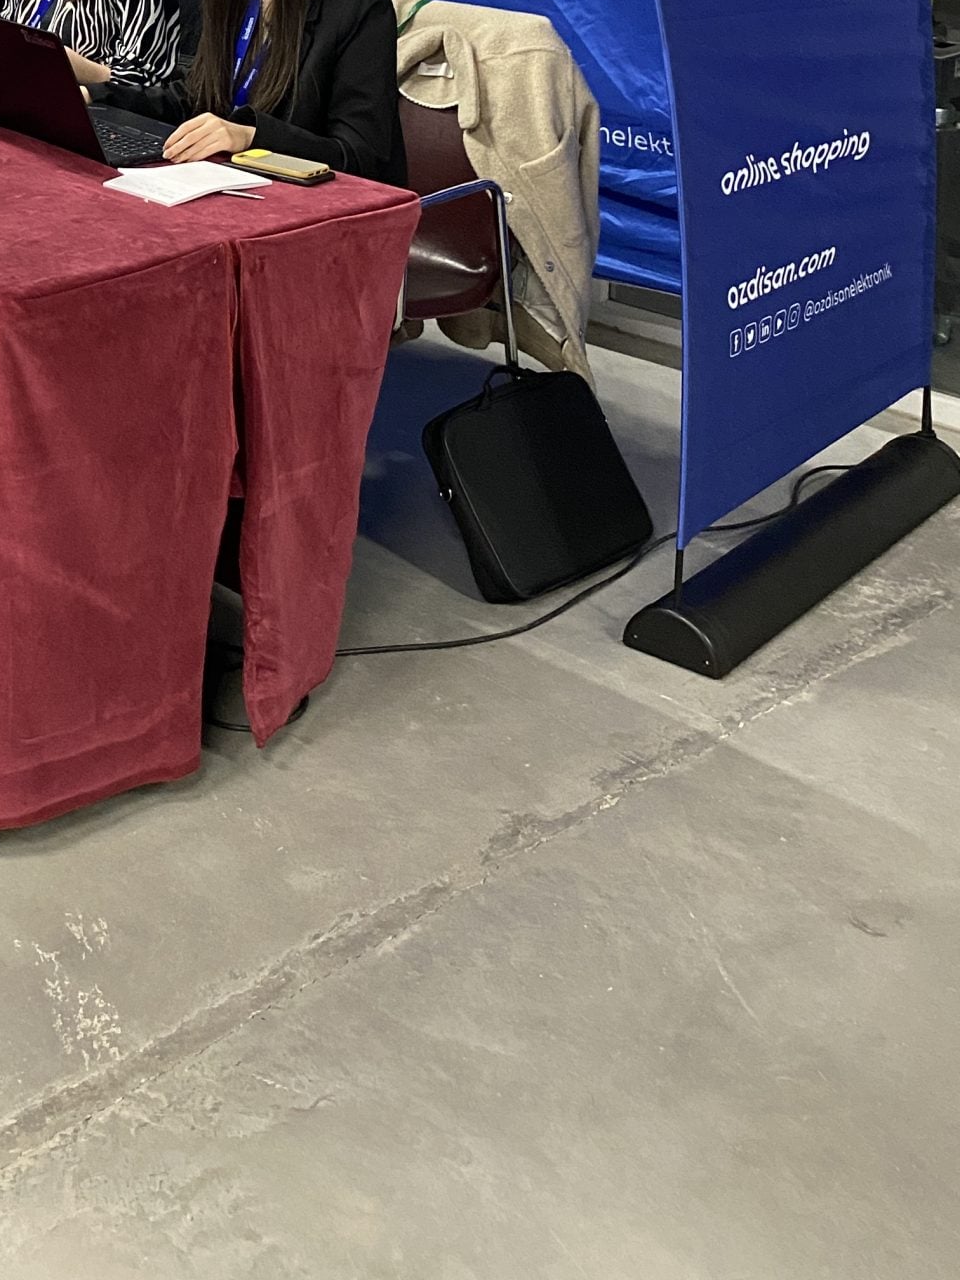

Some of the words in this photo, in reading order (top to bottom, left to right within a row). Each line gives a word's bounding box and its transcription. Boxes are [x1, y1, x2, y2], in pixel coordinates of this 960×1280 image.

[600, 125, 674, 157] nelekt
[721, 154, 781, 195] online
[780, 128, 870, 174] shopping
[727, 246, 836, 309] ozdisan.com
[804, 262, 893, 322] @ozdisanelektronik
